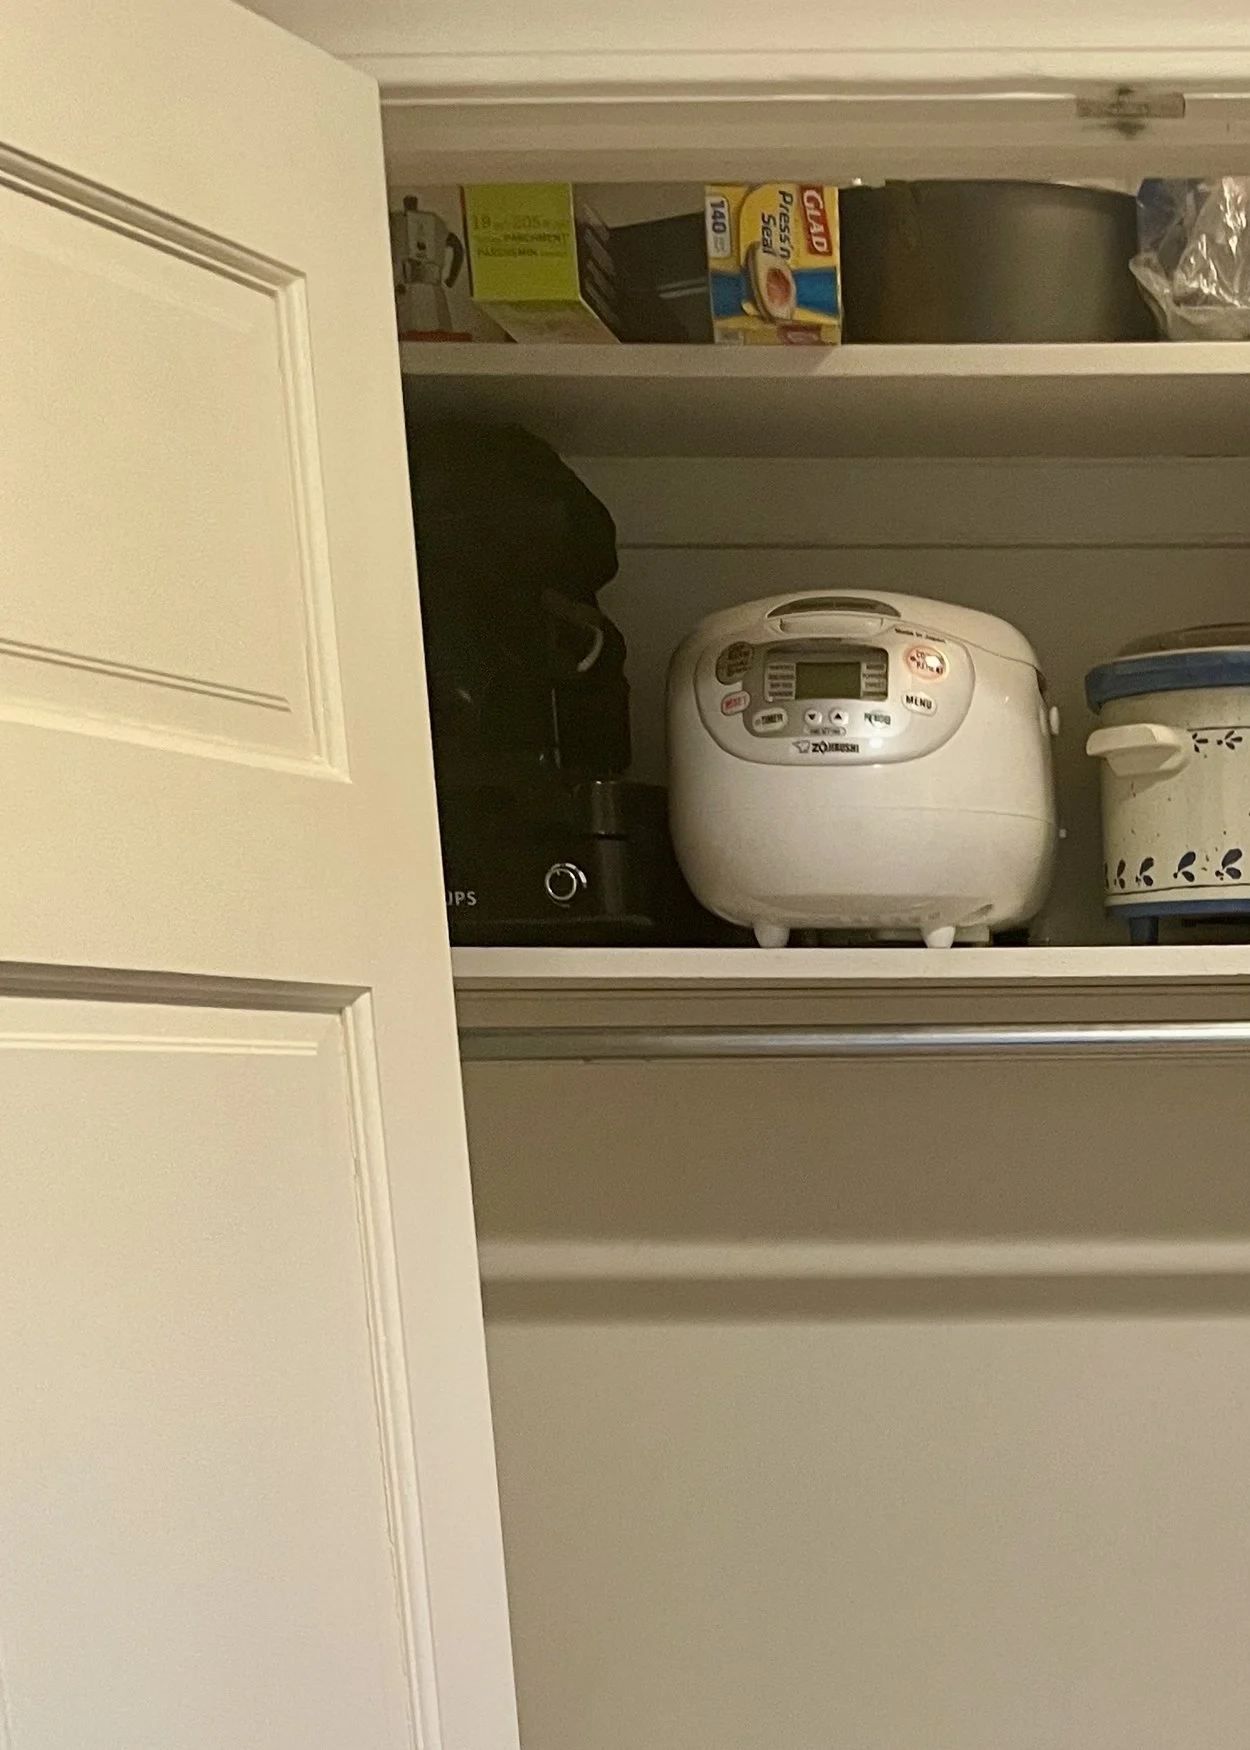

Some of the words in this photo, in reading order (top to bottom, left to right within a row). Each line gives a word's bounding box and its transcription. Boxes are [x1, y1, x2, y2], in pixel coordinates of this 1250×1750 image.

[710, 200, 727, 233] 140
[761, 212, 777, 257] Seal
[803, 189, 828, 253] GLAD
